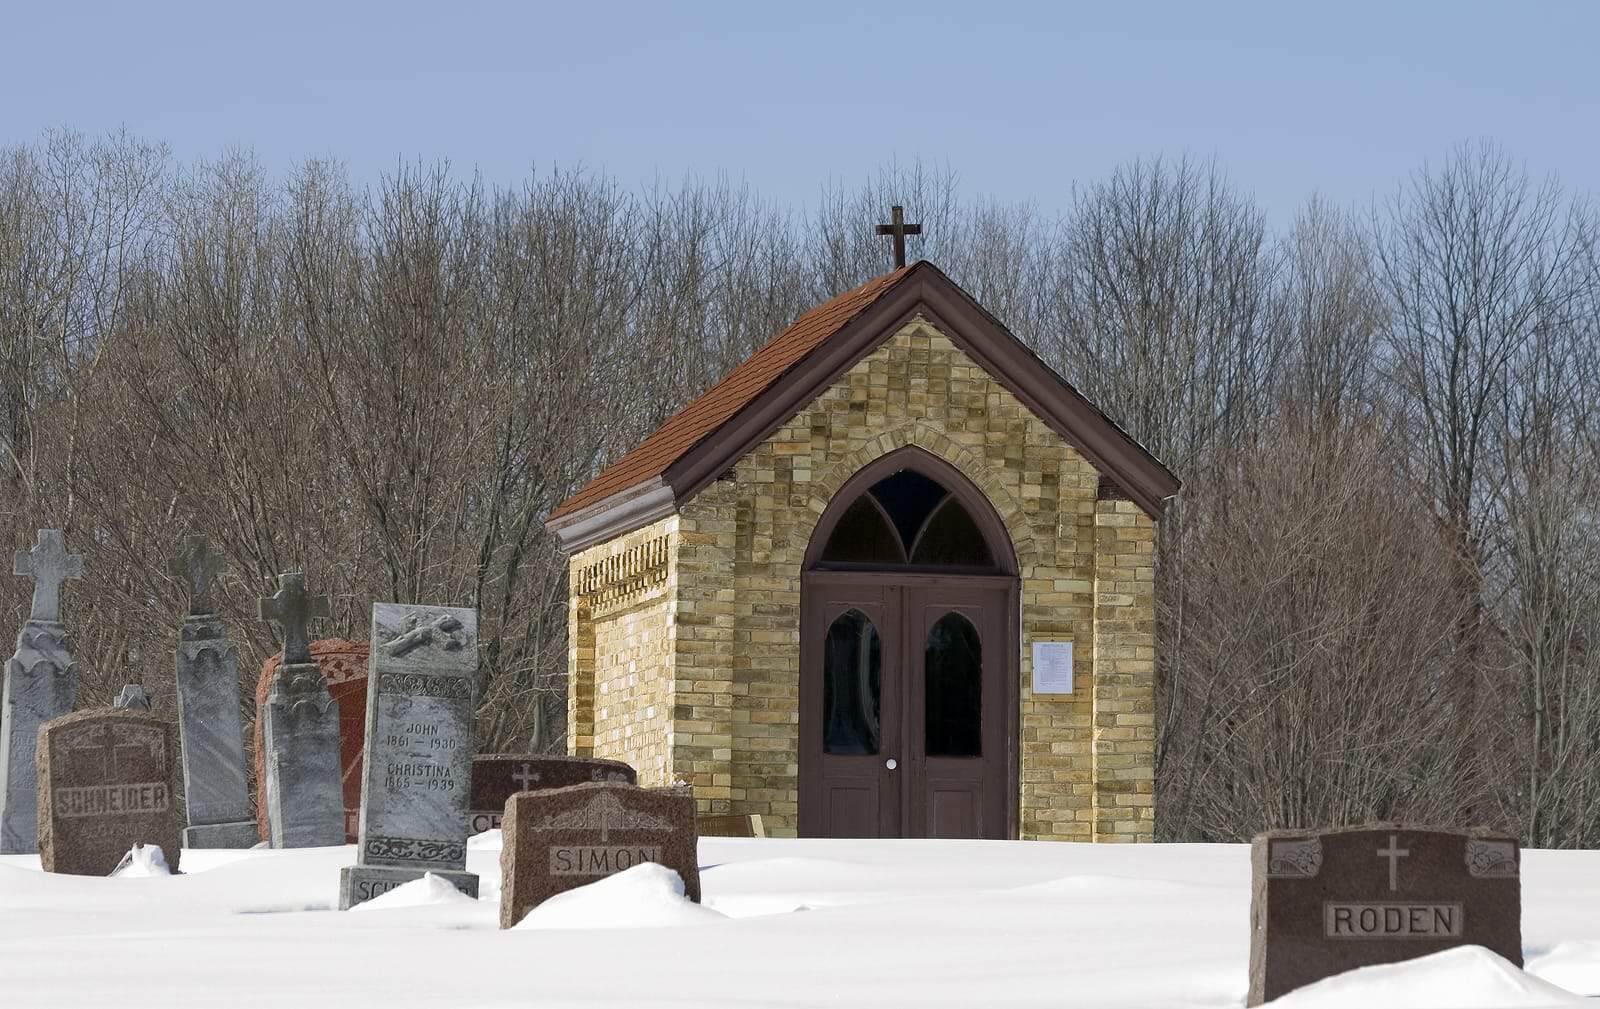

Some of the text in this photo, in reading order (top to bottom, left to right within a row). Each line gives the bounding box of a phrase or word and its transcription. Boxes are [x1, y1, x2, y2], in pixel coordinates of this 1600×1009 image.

[407, 723, 439, 736] JOHN
[387, 735, 409, 748] 1861
[430, 738, 456, 750] 1930
[387, 763, 452, 778] CHRISTINA
[428, 779, 455, 792] 1939
[556, 848, 655, 872] SIMON
[1334, 907, 1454, 933] RODEN
